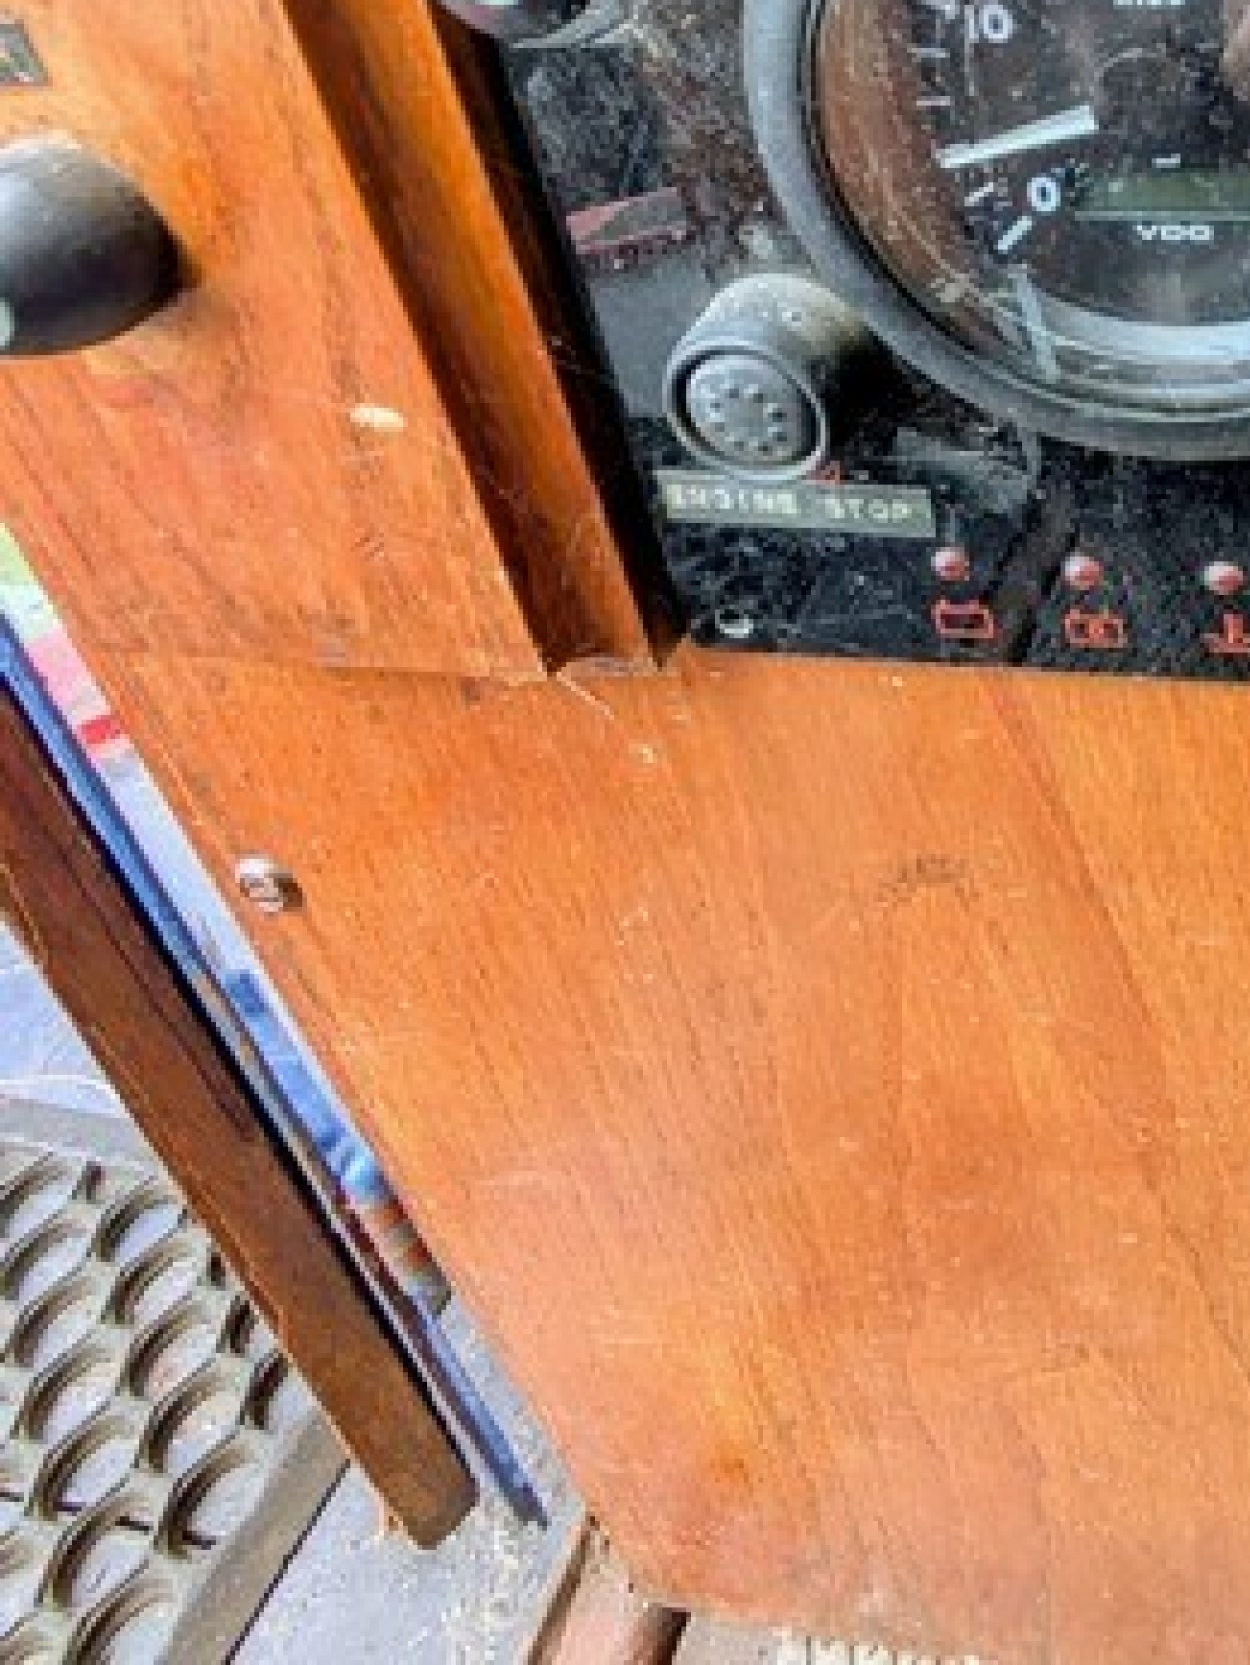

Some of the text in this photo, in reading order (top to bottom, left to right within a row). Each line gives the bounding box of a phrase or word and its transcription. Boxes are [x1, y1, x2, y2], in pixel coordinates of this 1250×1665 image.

[963, 2, 1014, 44] 10
[1027, 176, 1060, 213] 0
[1136, 224, 1215, 243] VDO
[822, 497, 913, 521] STOP
